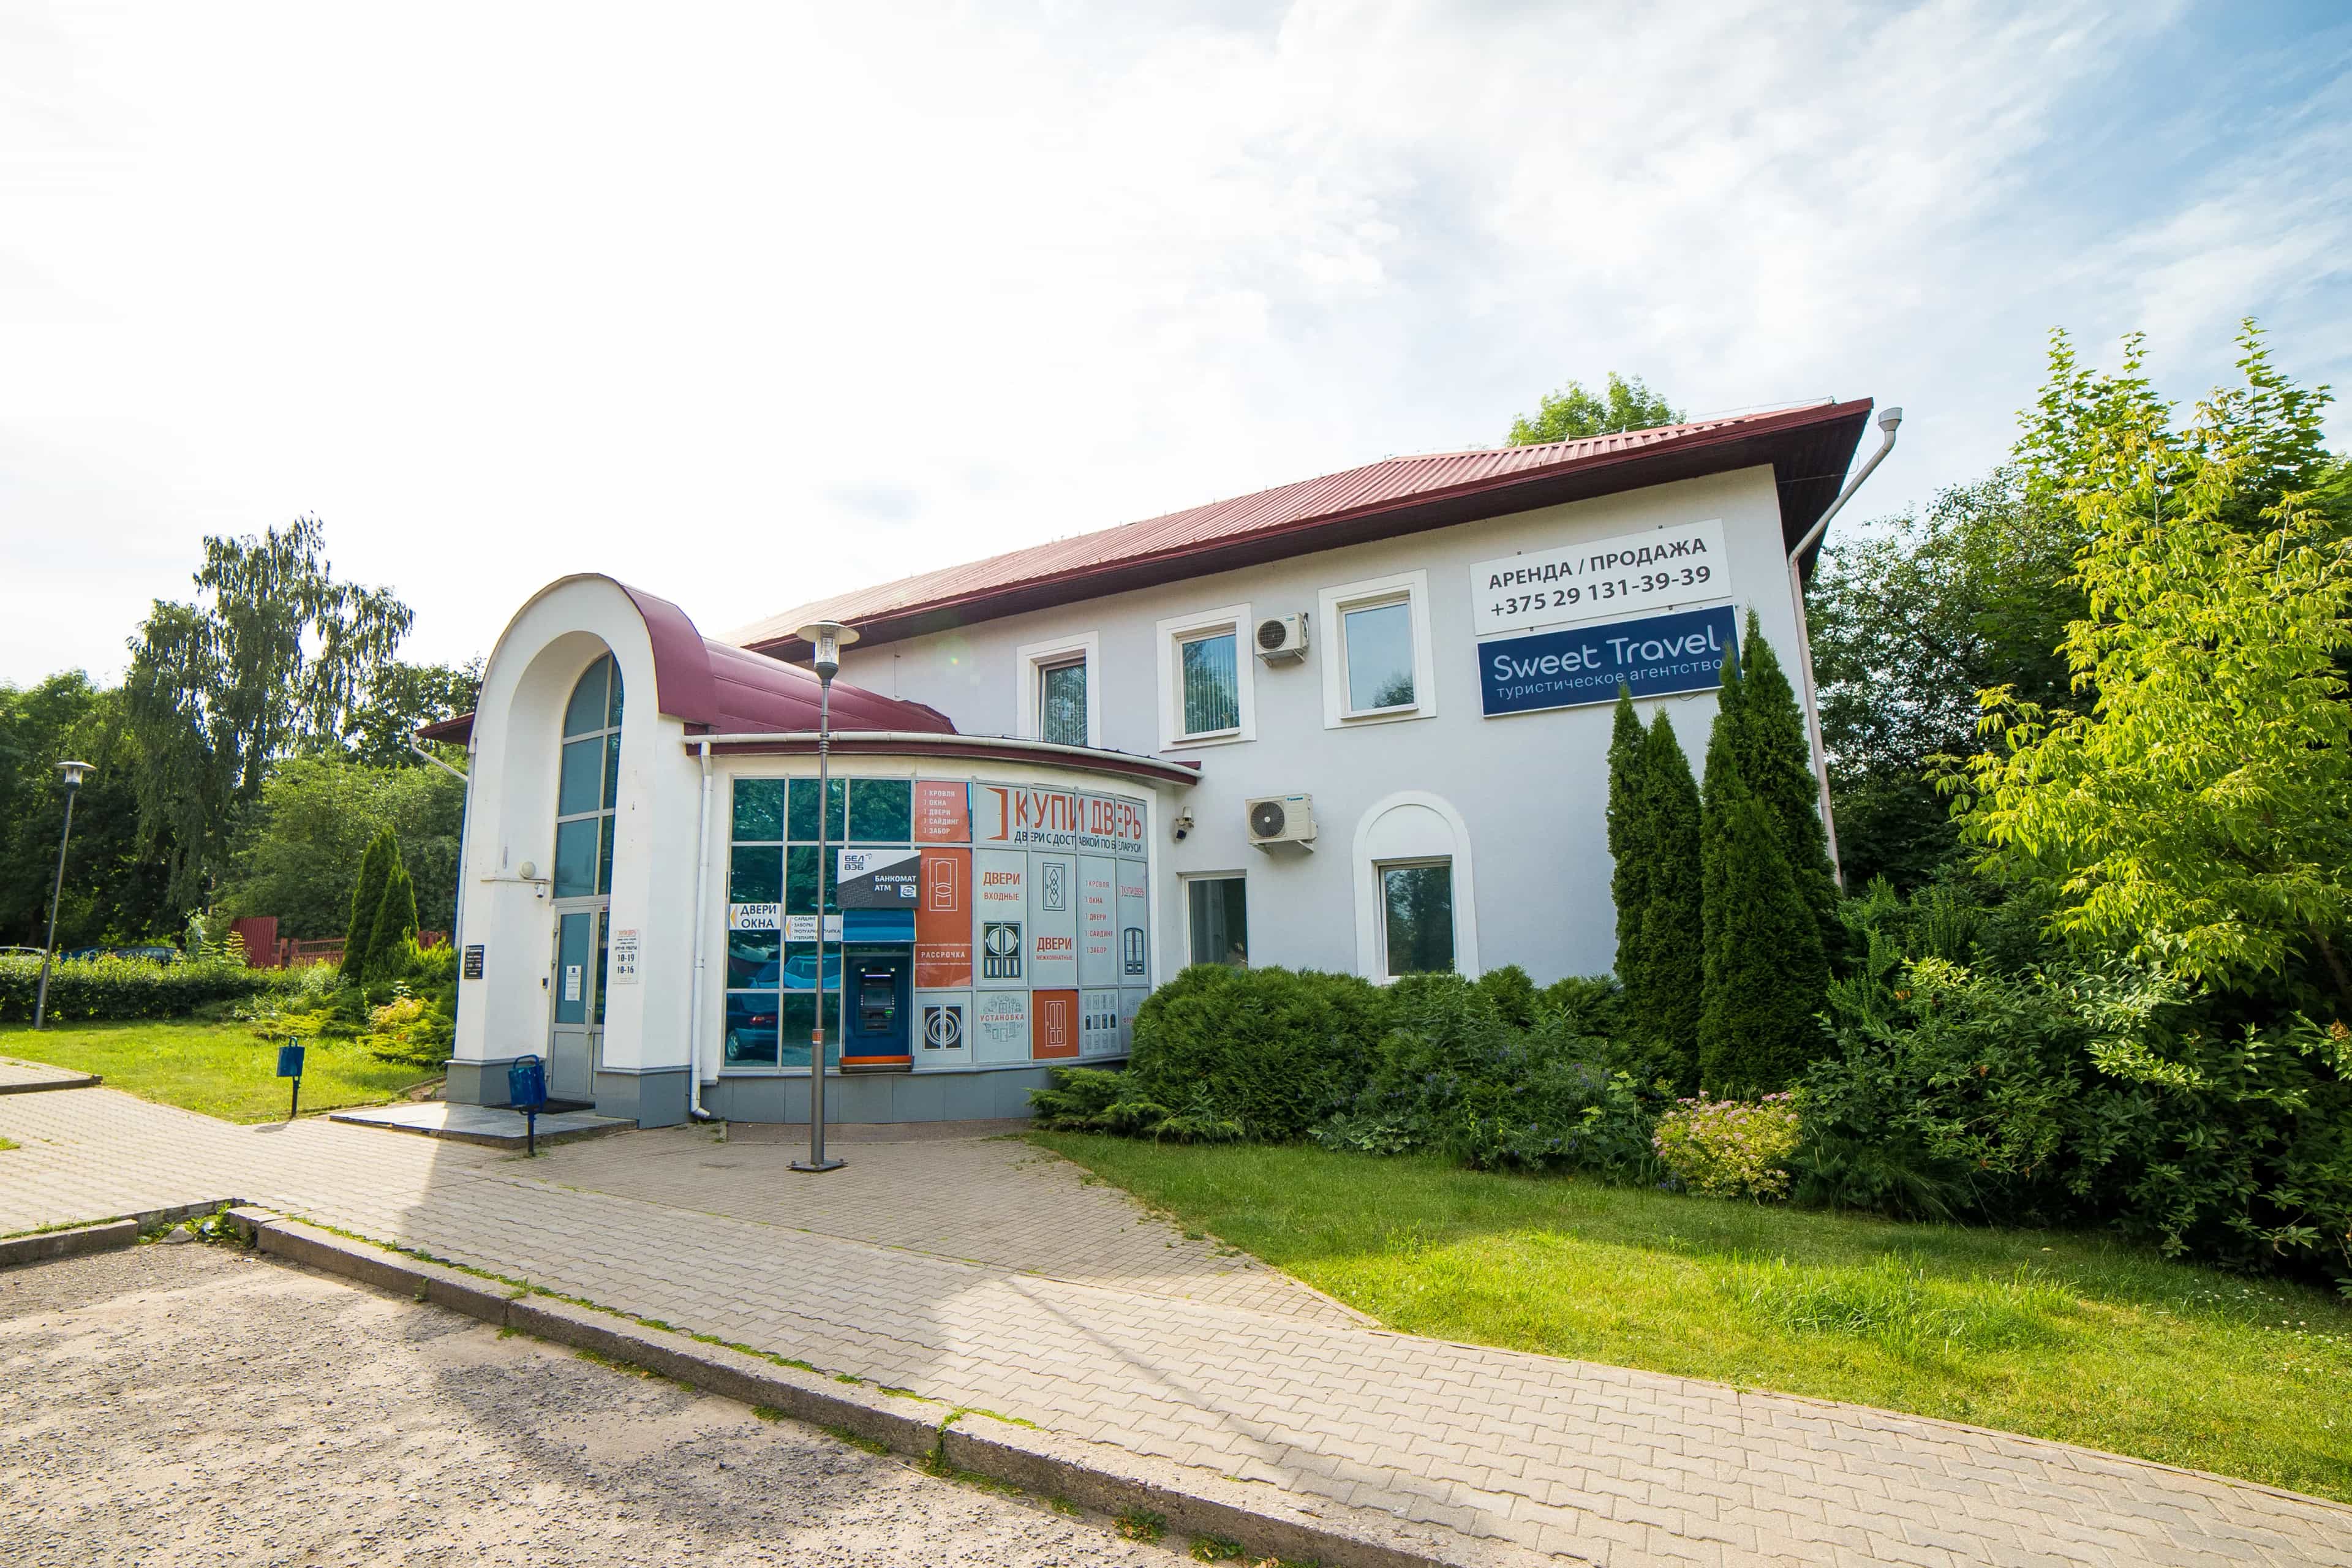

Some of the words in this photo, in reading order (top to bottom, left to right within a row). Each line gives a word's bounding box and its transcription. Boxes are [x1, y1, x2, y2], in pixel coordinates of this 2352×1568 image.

[1489, 562, 1573, 589] АРЕНДА
[1578, 558, 1585, 575] /
[1590, 538, 1707, 571] ПРОДАЖА
[1491, 593, 1546, 616] +375
[1553, 587, 1580, 607] 29
[1588, 566, 1711, 600] 131-39-39
[1494, 644, 1601, 681] Sweet
[1606, 625, 1721, 665] Travel
[1496, 673, 1624, 700] туристическое
[1630, 659, 1723, 681] агентство
[1016, 791, 1084, 832] КУПИ
[1091, 800, 1142, 840] ДВЕРЬ
[1014, 831, 1045, 843] ДВЕРИ
[1046, 833, 1052, 843] С
[1053, 834, 1100, 848] ДОСТАВКОЙ
[1101, 839, 1110, 849] ПО
[1111, 840, 1141, 853] БЕЛАРУСИ
[983, 872, 1020, 886] ДВЕРИ
[984, 892, 1020, 902] ВХОДНЫЕ
[740, 905, 776, 916] ДВЕРИ
[741, 919, 774, 928] ОКНА
[1037, 937, 1072, 952] ДВЕРИ
[617, 965, 634, 974] 10-16
